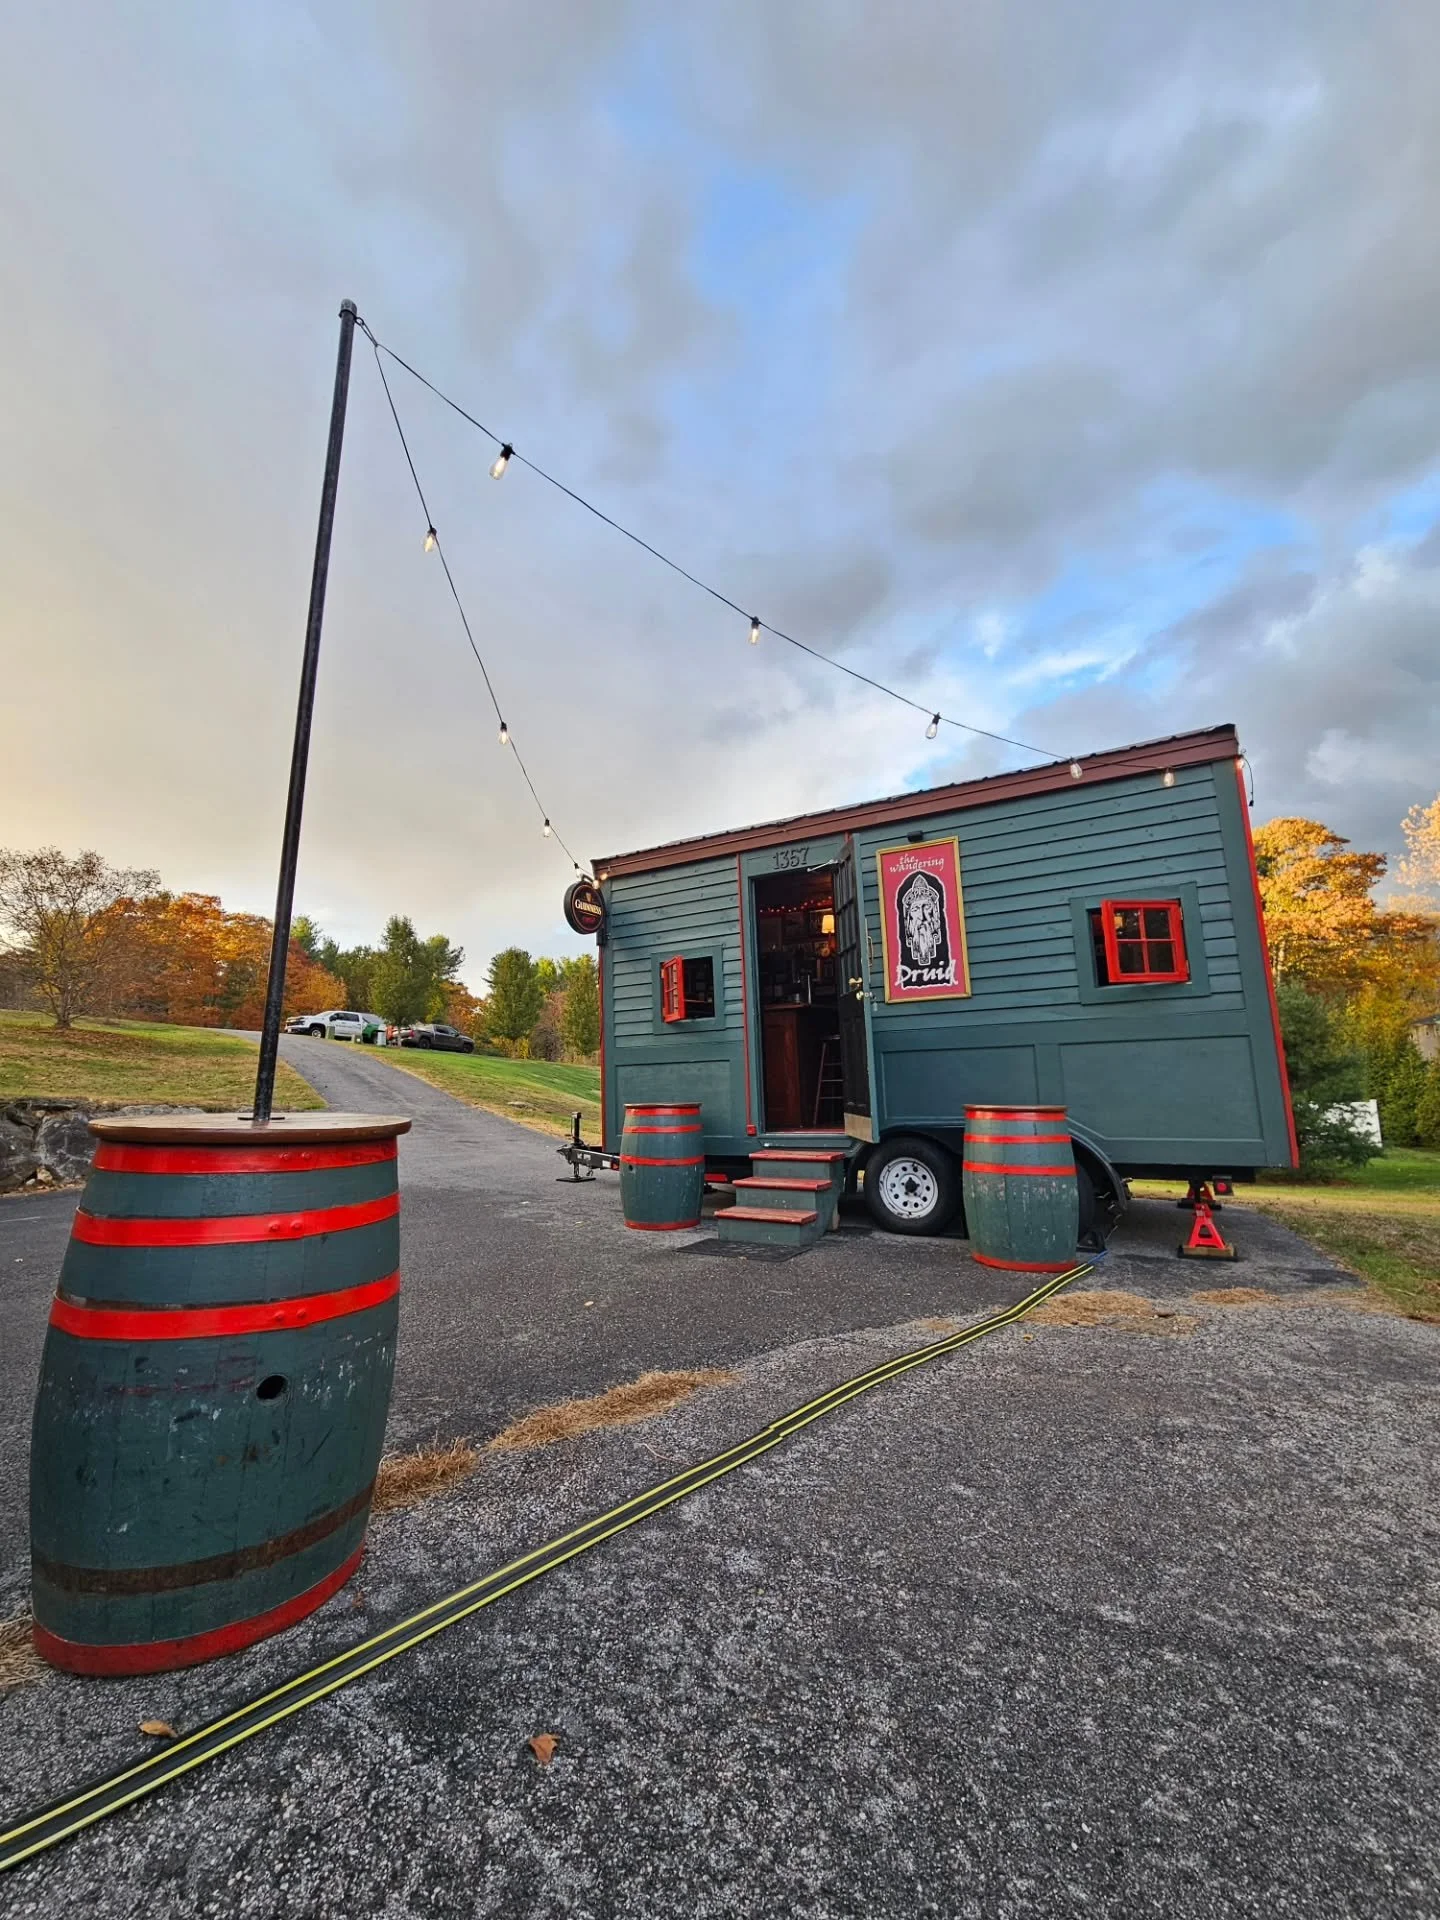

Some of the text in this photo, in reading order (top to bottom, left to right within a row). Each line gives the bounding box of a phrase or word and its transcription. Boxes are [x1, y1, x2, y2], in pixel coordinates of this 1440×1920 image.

[772, 847, 809, 870] 1357
[889, 857, 945, 873] wandering
[899, 853, 915, 865] the
[574, 899, 602, 916] GUINNESS
[895, 959, 959, 987] Druid
